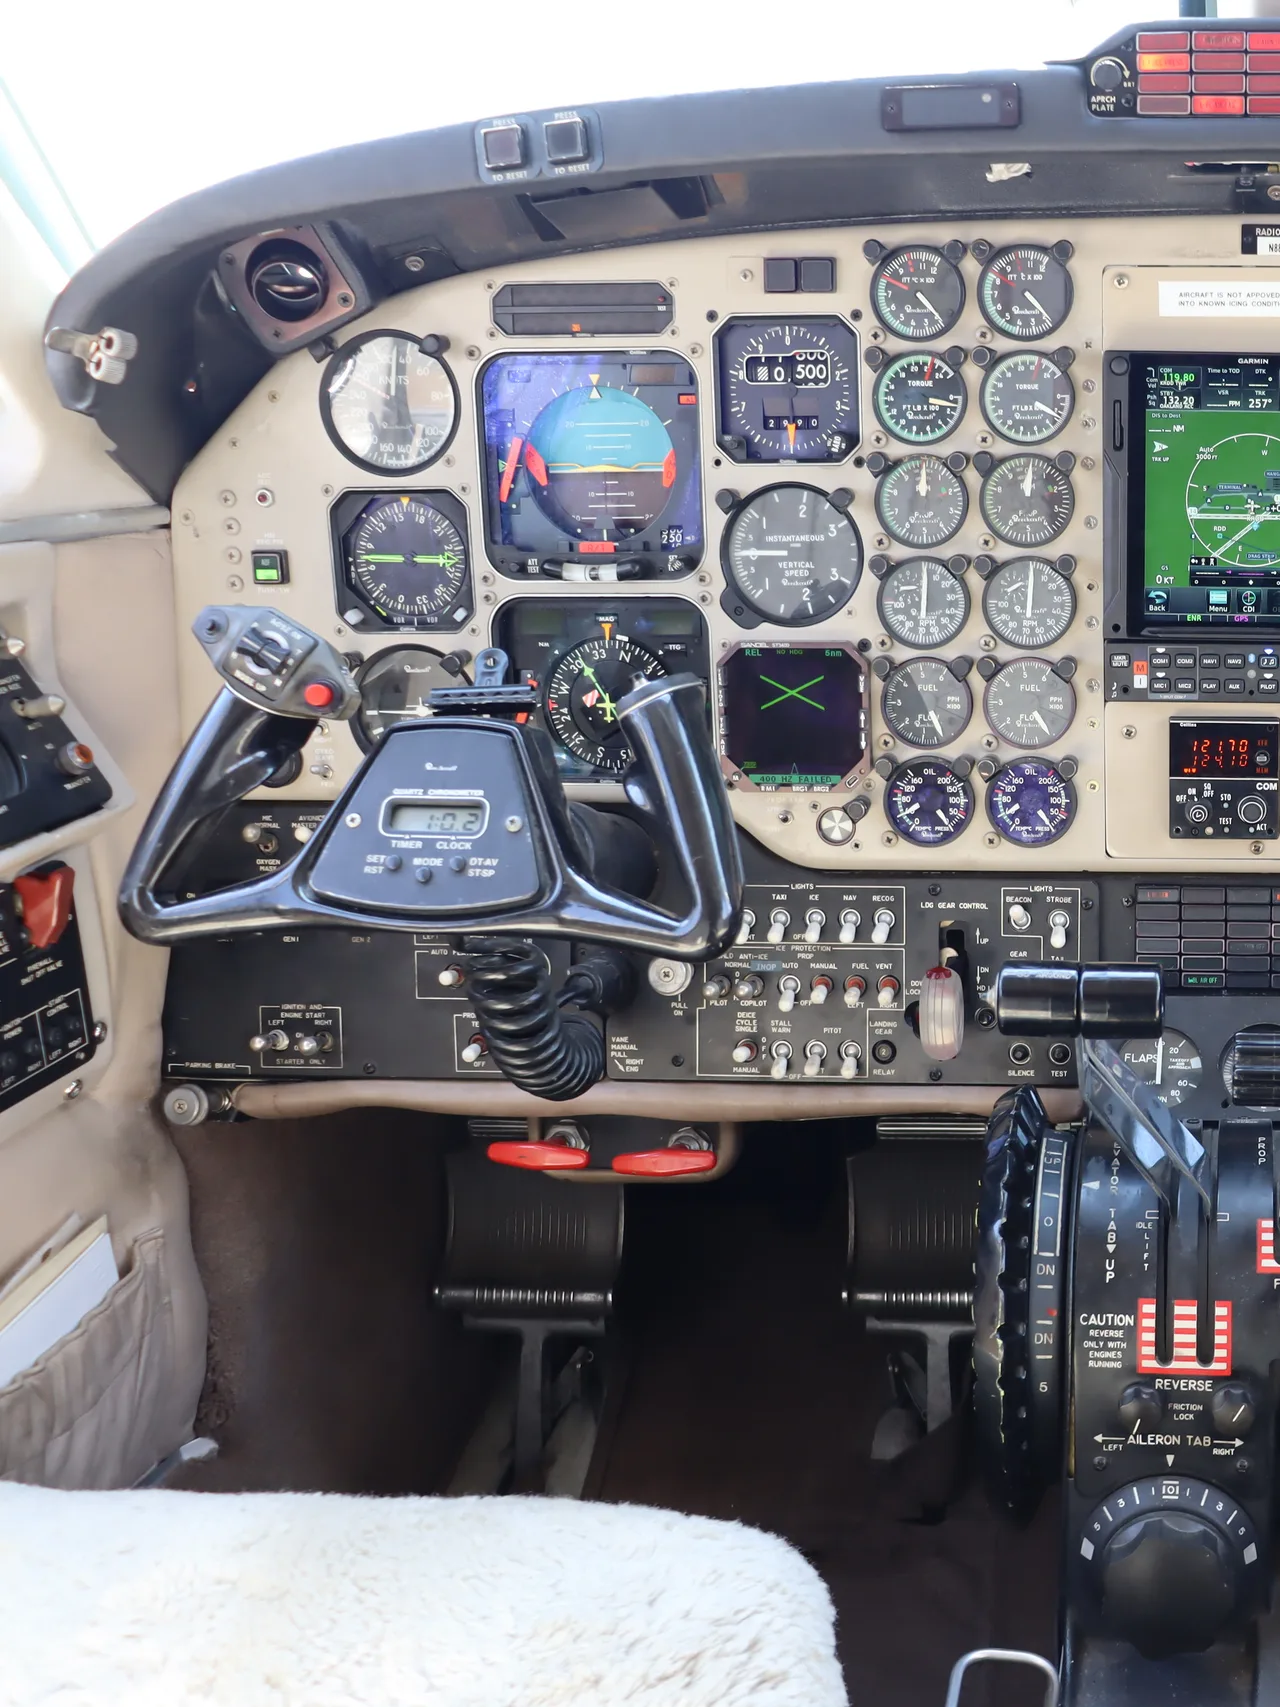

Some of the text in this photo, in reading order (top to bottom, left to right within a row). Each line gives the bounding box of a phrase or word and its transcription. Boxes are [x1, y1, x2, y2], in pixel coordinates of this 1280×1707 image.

[506, 171, 527, 179] RESET
[1256, 228, 1280, 236] RADIO
[1163, 374, 1194, 382] 119.80
[1163, 397, 1194, 405] 132.20
[785, 569, 809, 577] SPEED
[760, 775, 777, 783] 400
[799, 775, 832, 783] FAILED
[1256, 783, 1277, 791] COM
[1219, 817, 1232, 825] TEST
[413, 858, 442, 866] MODE
[756, 963, 777, 971] INOP
[1124, 1053, 1157, 1063] FLAPS
[1008, 1069, 1034, 1077] SILENCE
[1037, 1265, 1055, 1276] DN
[1080, 1314, 1134, 1326] CAUTION
[1090, 1330, 1124, 1338] REVERSE
[1155, 1379, 1212, 1391] REVERSE
[1127, 1435, 1211, 1446] AILERON TAB
